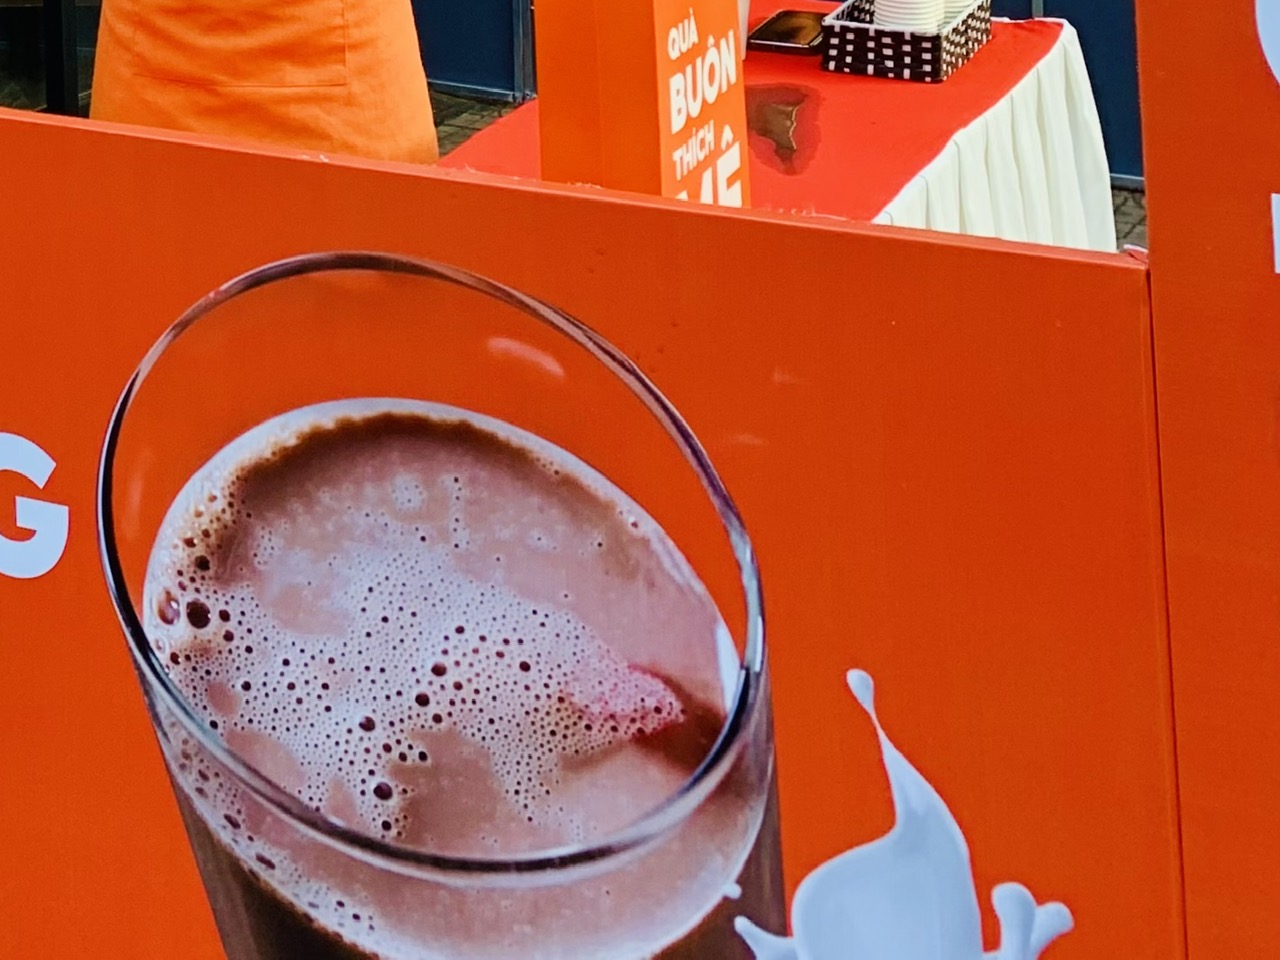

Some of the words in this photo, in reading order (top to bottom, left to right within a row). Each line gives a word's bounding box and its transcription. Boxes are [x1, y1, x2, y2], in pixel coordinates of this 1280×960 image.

[667, 6, 699, 62] QUÀ
[668, 28, 737, 135] BUÔN
[672, 119, 715, 181] THÍCH
